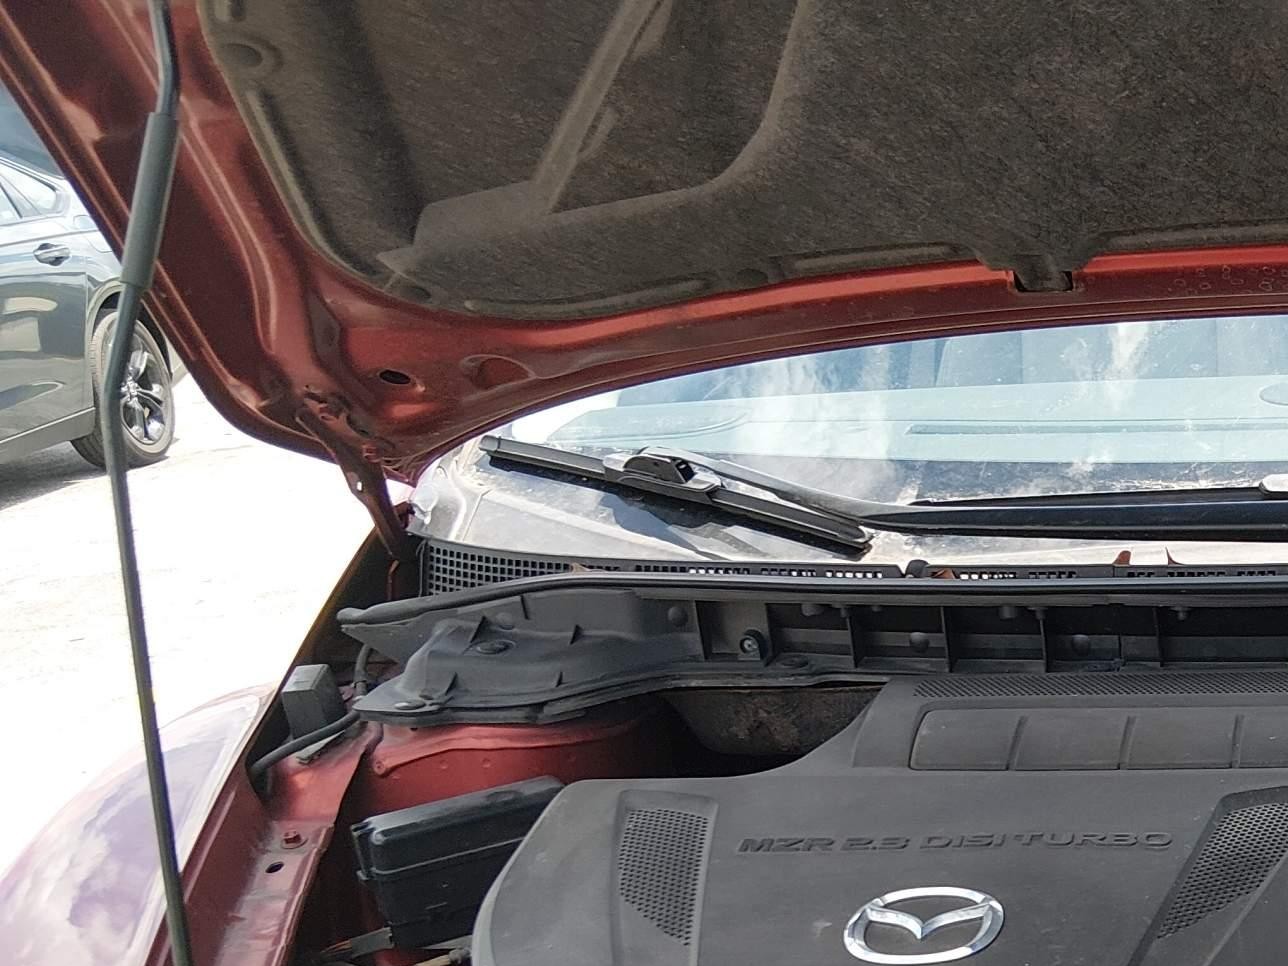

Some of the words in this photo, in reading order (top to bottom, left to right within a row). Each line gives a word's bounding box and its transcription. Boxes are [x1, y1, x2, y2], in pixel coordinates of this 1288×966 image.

[735, 837, 835, 854] MZR
[919, 834, 1005, 850] DISI
[1012, 831, 1175, 852] TURBO
